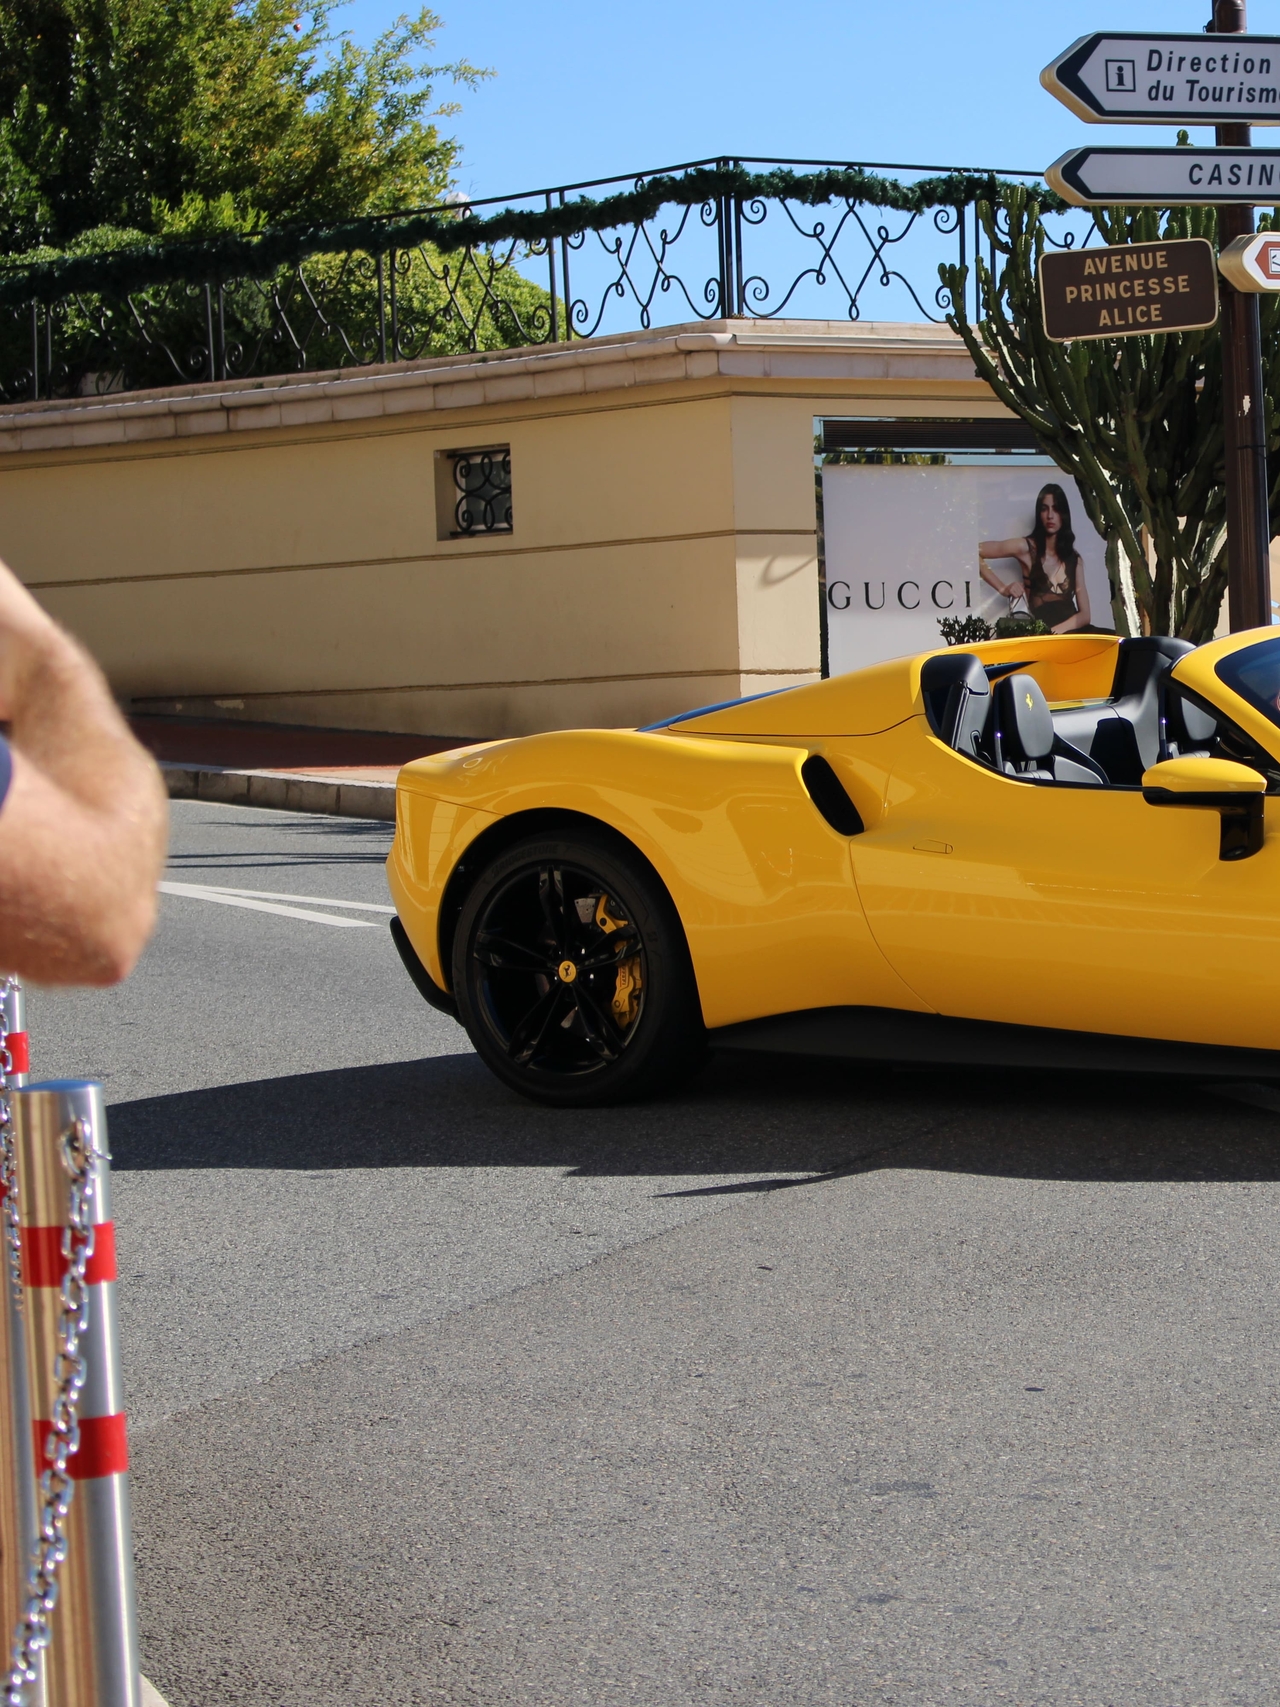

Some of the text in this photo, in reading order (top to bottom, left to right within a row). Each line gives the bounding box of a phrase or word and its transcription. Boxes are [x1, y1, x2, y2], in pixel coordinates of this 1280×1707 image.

[1147, 49, 1271, 74] Direction
[1148, 79, 1175, 101] du
[1083, 251, 1168, 275] AVENUE
[1065, 275, 1190, 303] PRINCESSE
[1099, 304, 1163, 327] ALICE
[828, 580, 972, 610] GUCCI
